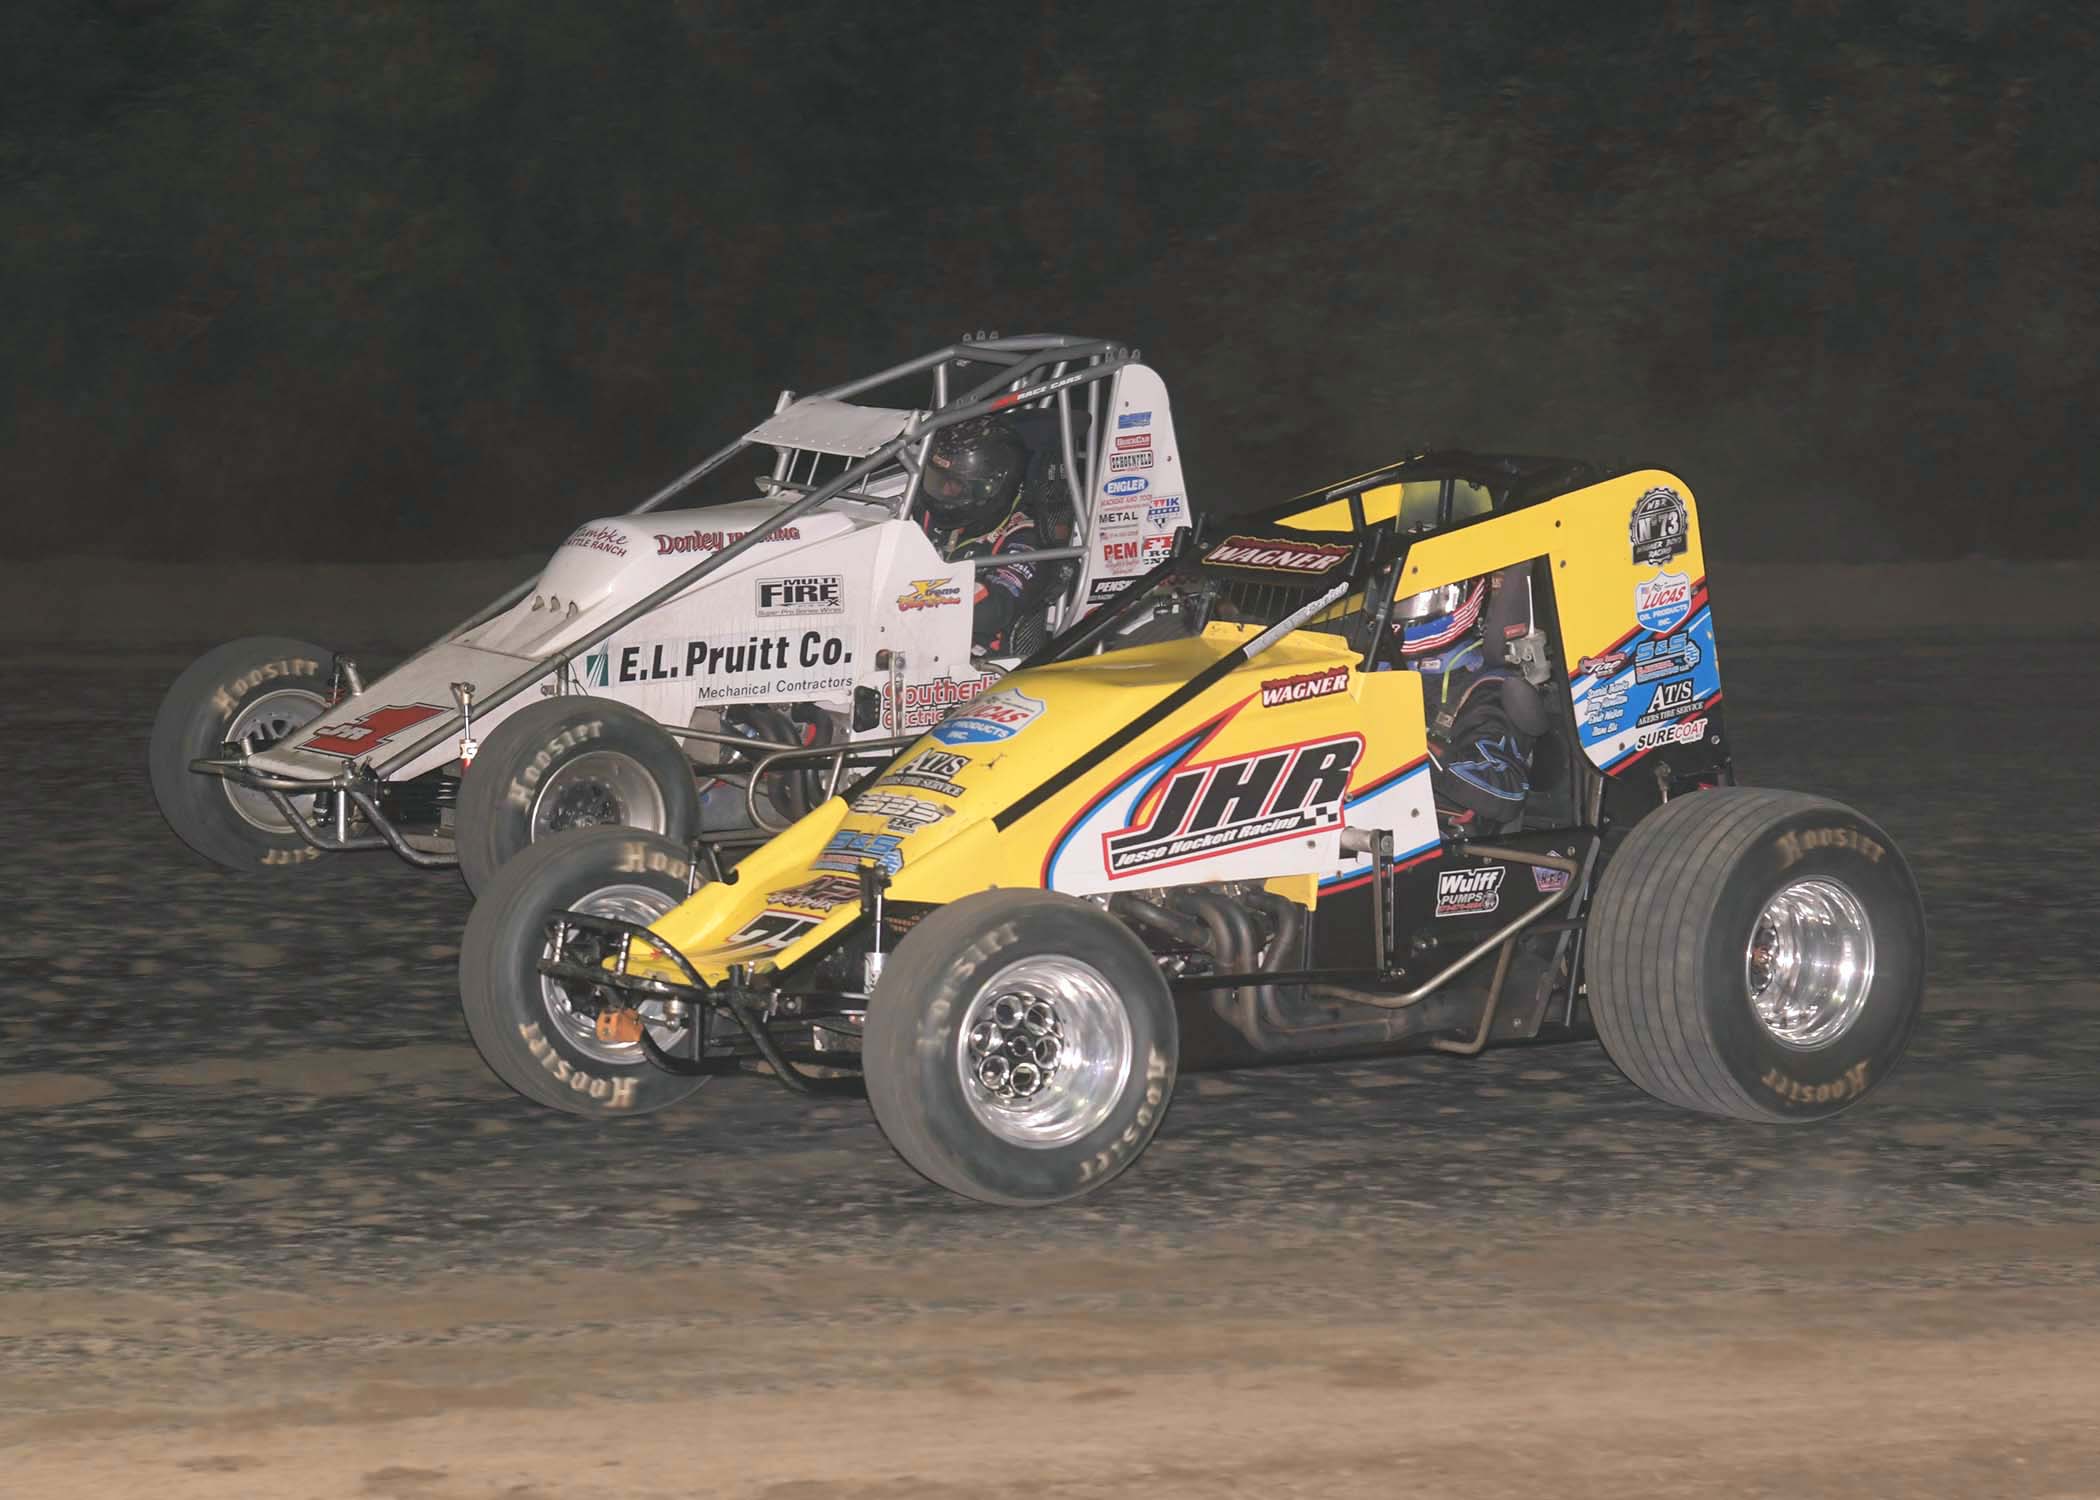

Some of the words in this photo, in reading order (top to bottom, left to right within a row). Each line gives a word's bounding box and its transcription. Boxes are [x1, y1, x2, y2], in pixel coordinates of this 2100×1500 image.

[1107, 480, 1145, 493] ENGLER
[1099, 512, 1139, 523] METAL
[590, 540, 627, 557] RANCH
[653, 530, 725, 555] Donley
[1103, 542, 1138, 560] PEM
[1208, 546, 1341, 570] WAGNER
[761, 584, 838, 607] FIRE
[1643, 586, 1686, 610] LUCAS
[620, 645, 679, 682] E.L.
[685, 637, 789, 677] Pruitt
[799, 631, 853, 668] Co.
[1636, 633, 1687, 660] S&S
[698, 682, 771, 700] Mechanical
[776, 676, 853, 693] Contractors
[1263, 675, 1347, 706] WAGNER
[1638, 713, 1660, 726] AKERS
[1660, 709, 1676, 719] TIRE
[1676, 702, 1704, 715] SERVICE
[1637, 721, 1706, 750] SURECOAT
[1110, 738, 1360, 848] JHR
[1238, 815, 1302, 841] Racing
[1441, 871, 1499, 894] Wulff
[1442, 892, 1483, 905] PUMPS
